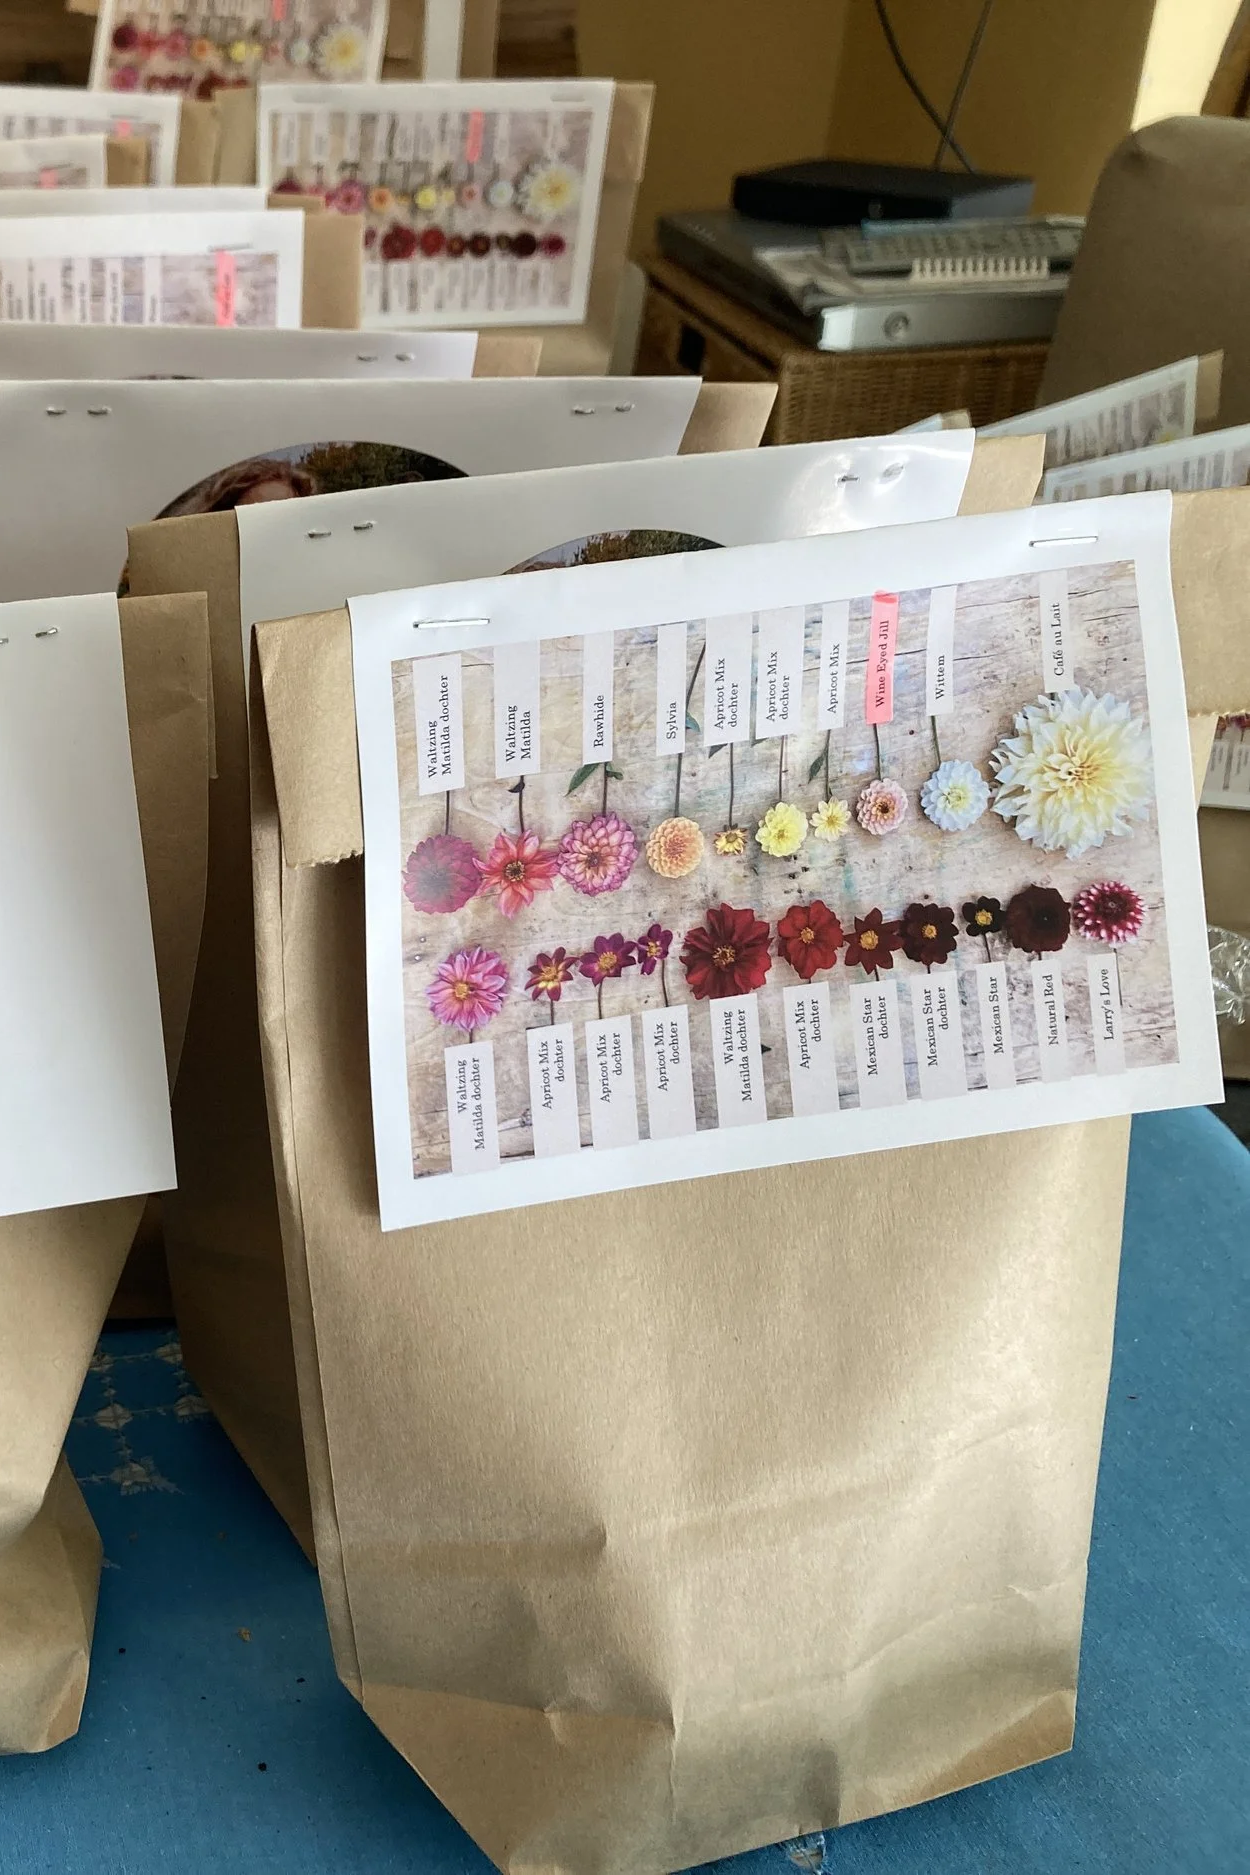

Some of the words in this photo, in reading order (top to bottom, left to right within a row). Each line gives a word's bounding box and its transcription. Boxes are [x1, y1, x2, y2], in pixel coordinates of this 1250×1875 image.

[879, 620, 889, 640] Jill
[1051, 603, 1061, 628] Lait
[829, 643, 840, 667] Mix
[877, 643, 888, 672] Eyed
[1055, 630, 1062, 646] au
[715, 658, 726, 682] Mix
[767, 651, 778, 675] Mix
[935, 655, 945, 700] Wittem
[1053, 649, 1064, 677] Café
[439, 675, 449, 721] dochter
[714, 685, 725, 730] Apricot
[728, 682, 738, 727] dochter
[766, 677, 777, 722] Apricot
[779, 675, 790, 720] dochter
[827, 671, 839, 714] Apricot
[876, 677, 886, 708] Wine
[505, 705, 517, 761] Waltzing
[520, 711, 530, 759] Matilda
[594, 695, 604, 747] Rawhide
[666, 701, 678, 739] Sylvia
[427, 720, 437, 778] Waltzing
[440, 725, 451, 775] Matilda
[923, 988, 932, 1014] Star
[988, 976, 998, 1001] Star
[1042, 974, 1054, 996] Red
[1100, 968, 1110, 995] Love
[795, 1000, 804, 1024] Mix
[810, 998, 821, 1042] dochter
[863, 997, 872, 1023] Star
[877, 995, 888, 1039] dochter
[937, 986, 948, 1030] dochter
[993, 1005, 1004, 1053] Mexican
[1045, 999, 1058, 1045] Natural
[1102, 999, 1114, 1040] Larry's
[539, 1040, 549, 1064] Mix
[597, 1034, 607, 1058] Mix
[654, 1022, 664, 1047] Mix
[669, 1021, 679, 1065] dochter
[723, 1011, 733, 1064] Waltzing
[737, 1009, 747, 1052] dochter
[798, 1025, 810, 1069] Apricot
[867, 1026, 878, 1075] Mexican
[927, 1017, 938, 1066] Mexican
[554, 1038, 564, 1082] dochter
[612, 1032, 622, 1075] dochter
[657, 1048, 669, 1092] Apricot
[457, 1059, 467, 1113] Waltzing
[470, 1058, 481, 1101] dochter
[542, 1066, 553, 1109] Apricot
[599, 1060, 611, 1103] Apricot
[739, 1055, 752, 1101] Matilda
[472, 1103, 485, 1150] Matilda
